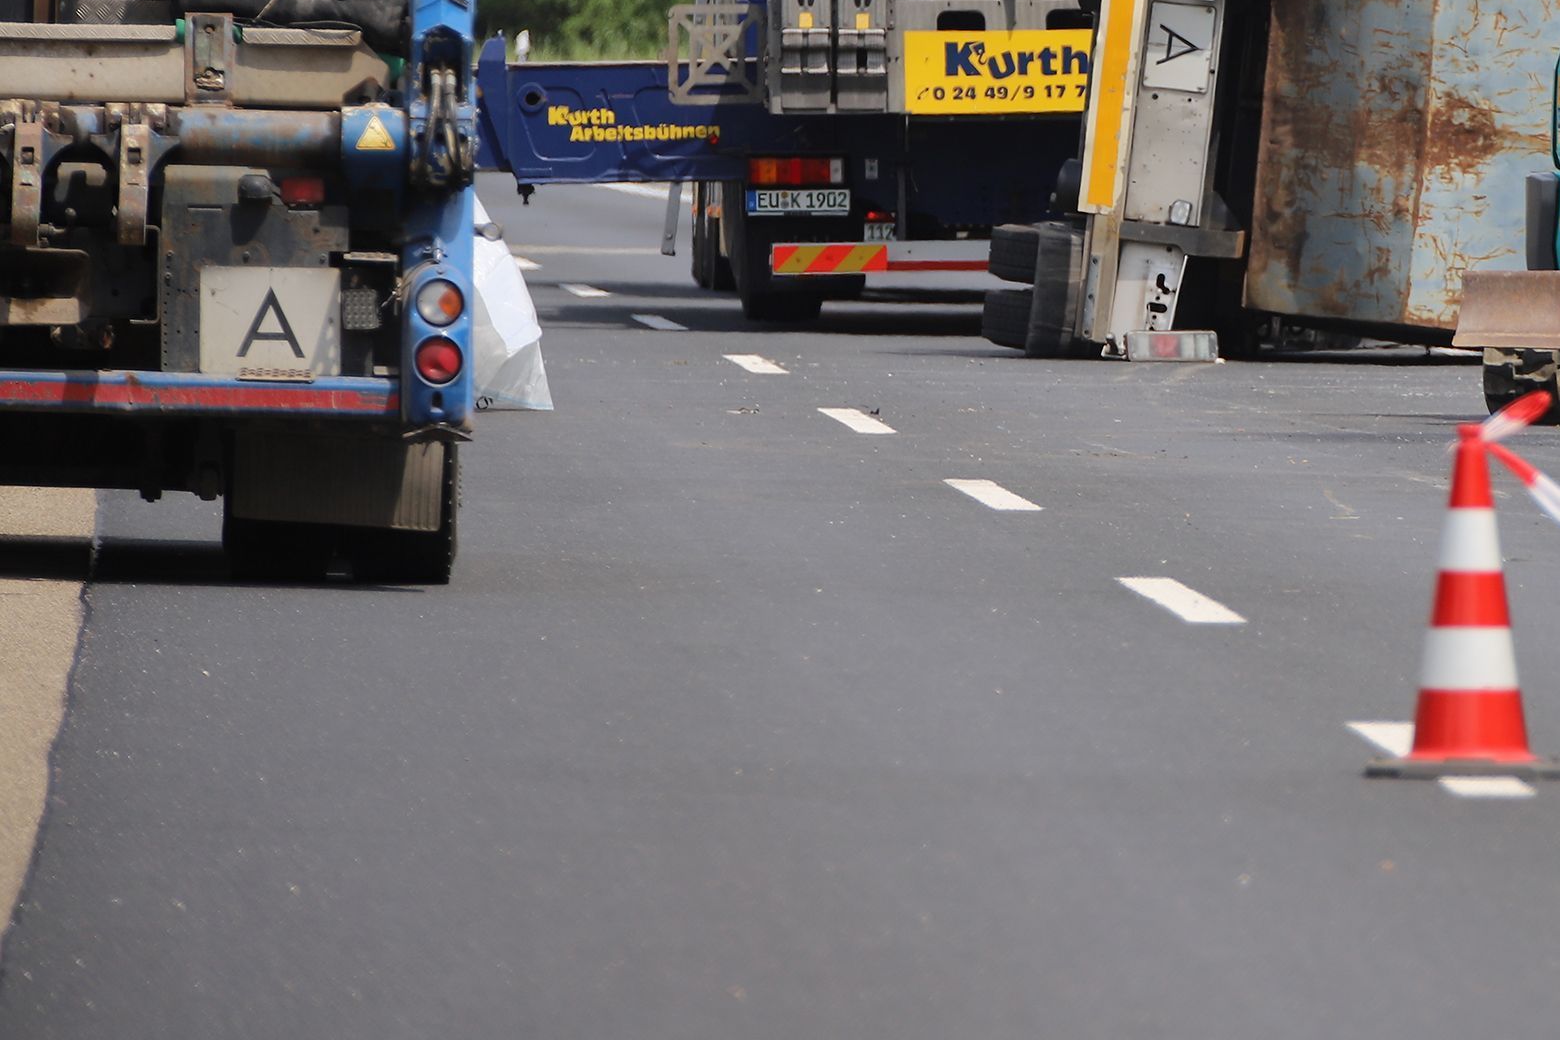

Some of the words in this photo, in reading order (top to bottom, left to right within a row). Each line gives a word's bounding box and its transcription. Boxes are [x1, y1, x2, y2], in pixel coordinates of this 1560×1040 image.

[1156, 23, 1200, 66] A
[944, 41, 1089, 80] Kurth
[932, 87, 946, 101] 0
[952, 86, 977, 101] 24
[1044, 85, 1066, 99] 17
[547, 105, 616, 126] Kurth
[569, 123, 721, 142] Arbeitsbühnen
[757, 191, 780, 209] EU
[805, 191, 848, 209] 1902
[235, 285, 306, 359] A
